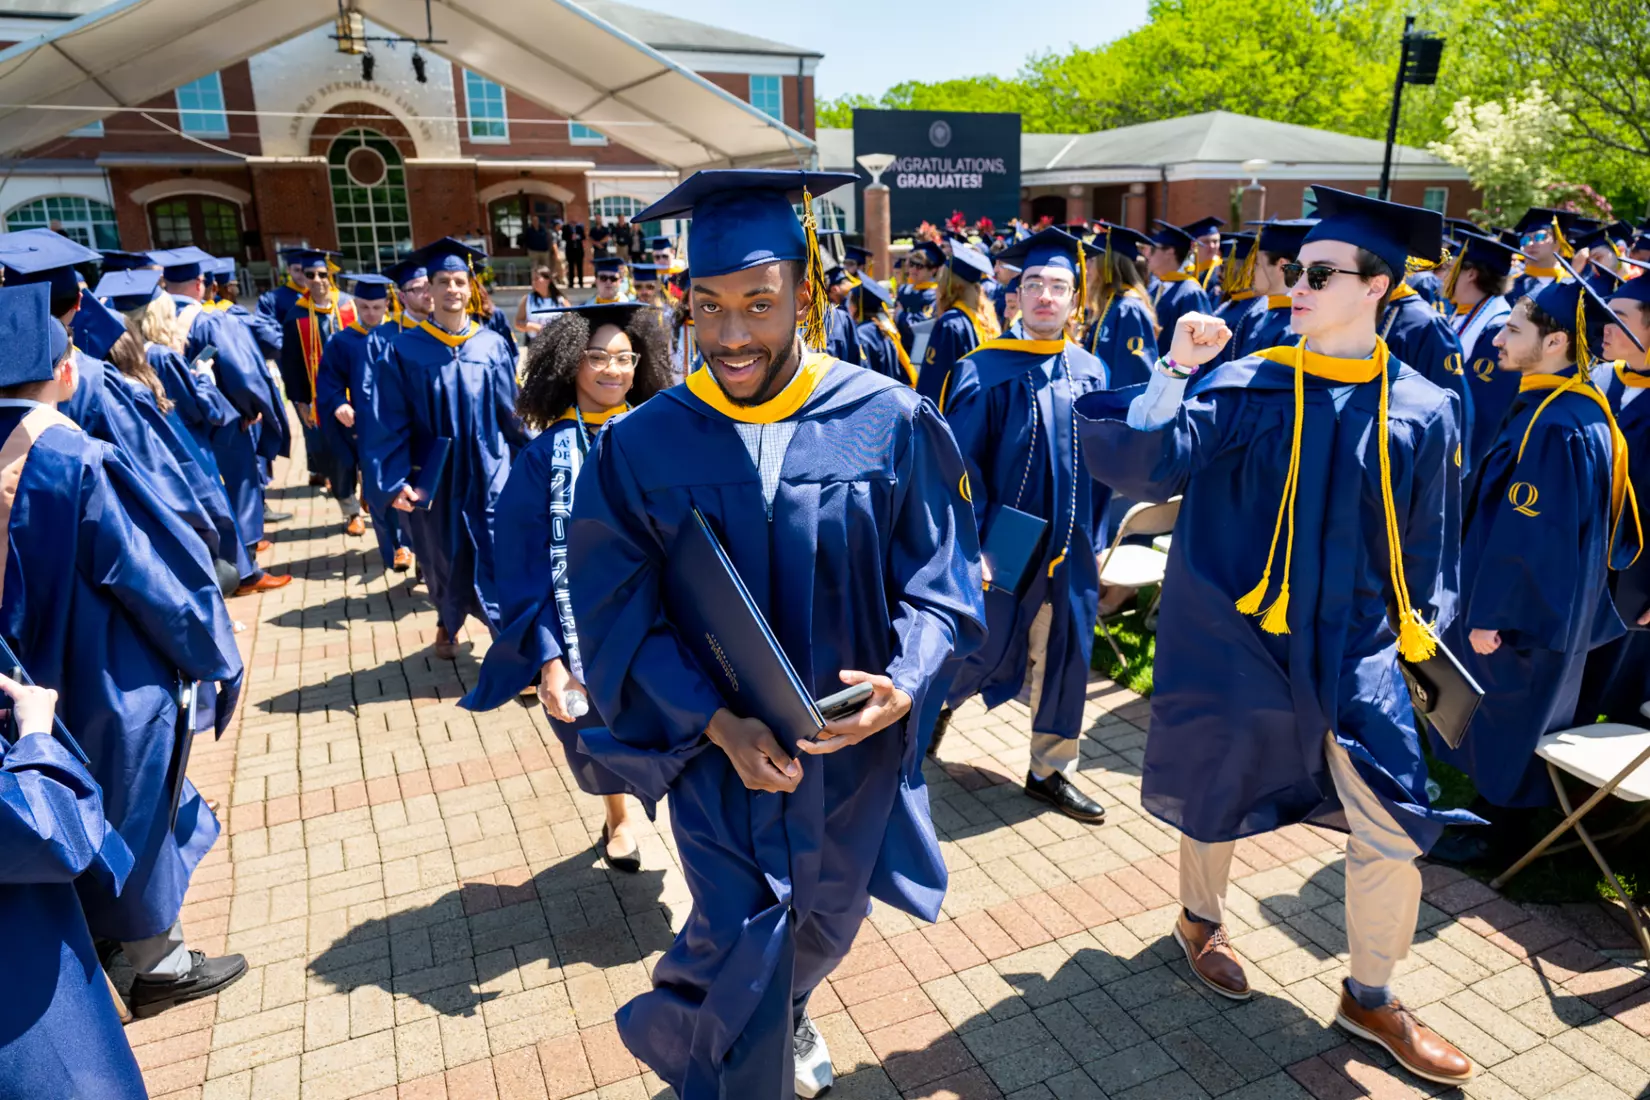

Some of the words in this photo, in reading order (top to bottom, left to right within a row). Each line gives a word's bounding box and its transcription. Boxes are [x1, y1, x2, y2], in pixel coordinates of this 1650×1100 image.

[896, 173, 983, 188] GRADUATES!
[1127, 336, 1145, 356] Q
[1473, 358, 1495, 383] Q
[1508, 482, 1541, 517] Q
